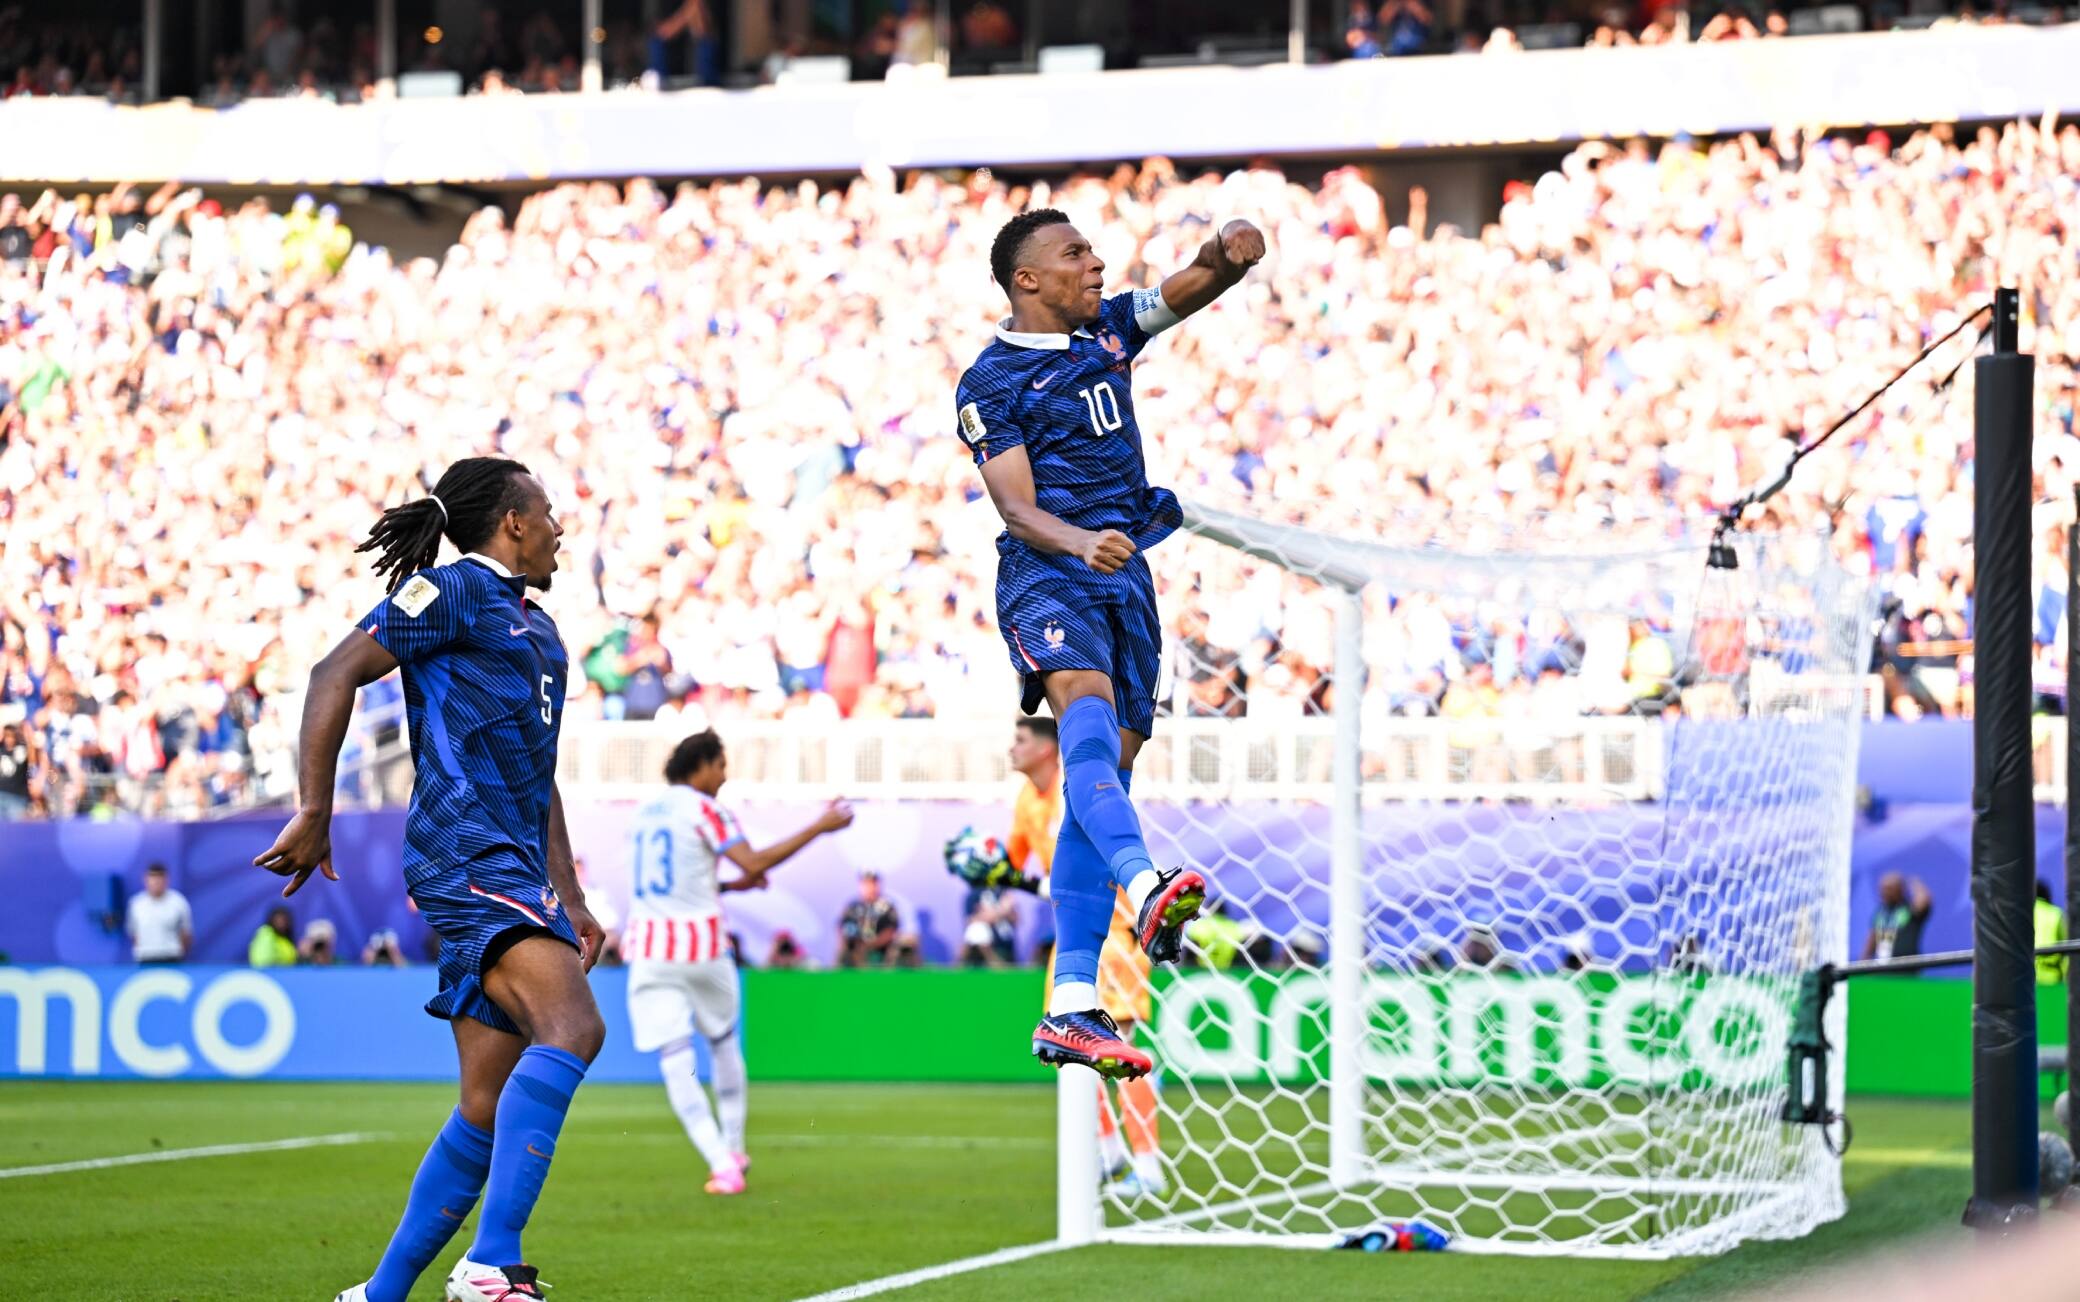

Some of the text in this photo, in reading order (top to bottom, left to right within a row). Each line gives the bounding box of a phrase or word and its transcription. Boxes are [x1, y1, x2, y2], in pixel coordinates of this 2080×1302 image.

[1079, 381, 1122, 437] 10
[540, 673, 553, 726] 5
[634, 827, 674, 900] 13
[0, 966, 297, 1077] mco
[1159, 972, 1786, 1084] aramco
